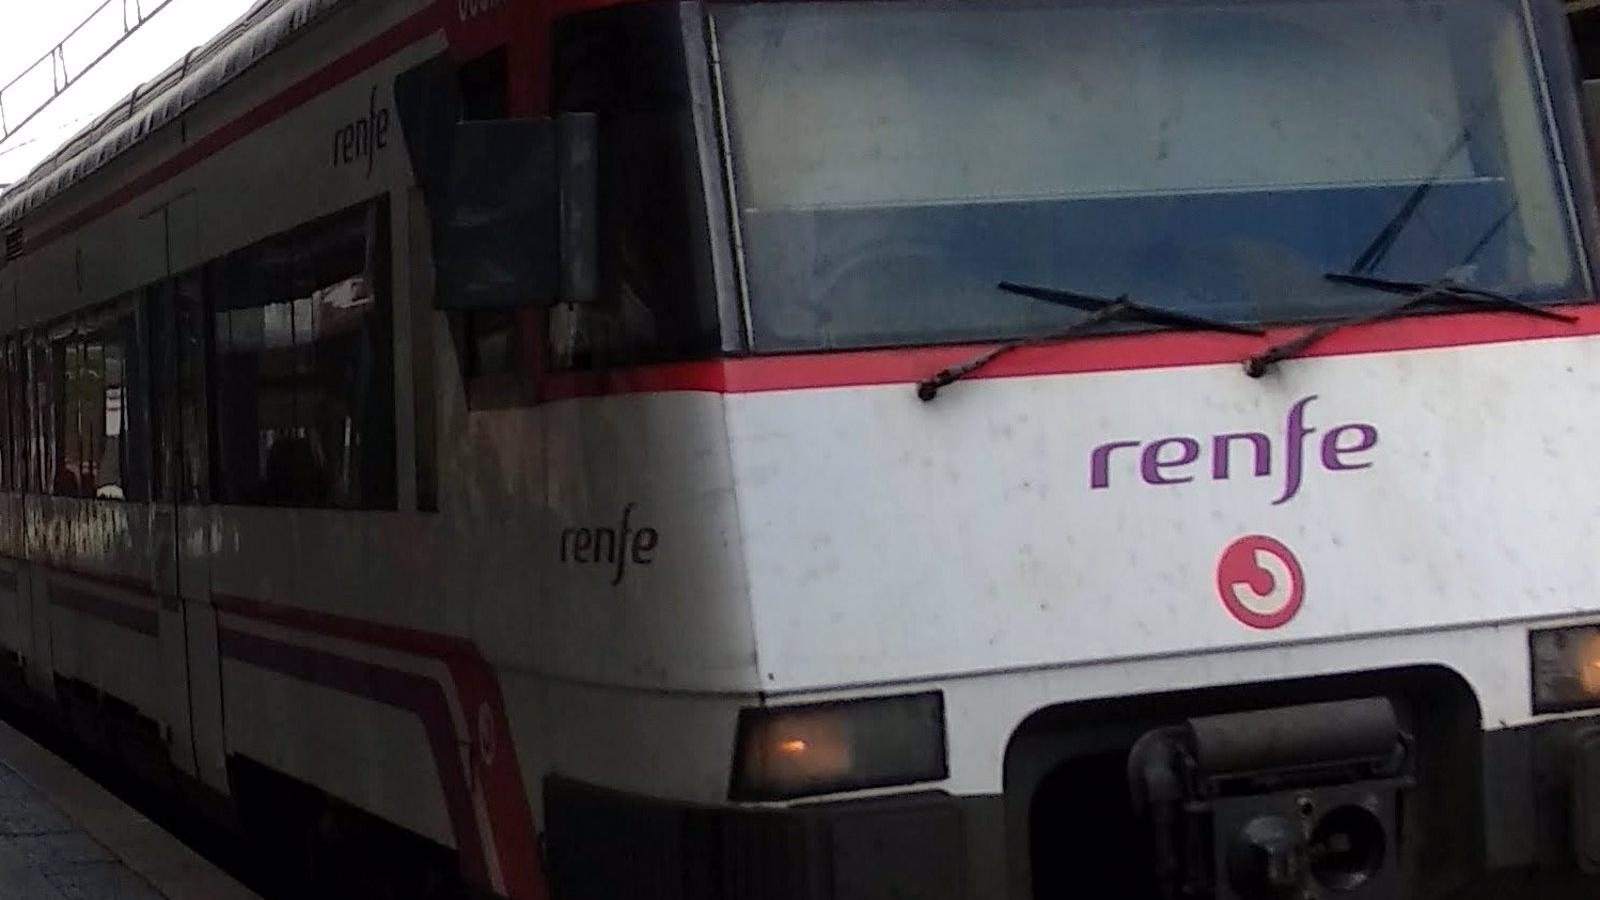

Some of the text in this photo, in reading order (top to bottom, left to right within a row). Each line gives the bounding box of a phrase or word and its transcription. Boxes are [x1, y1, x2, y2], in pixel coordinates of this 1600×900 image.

[333, 85, 389, 180] renfe
[1090, 395, 1378, 505] renfe
[561, 502, 658, 586] renfe
